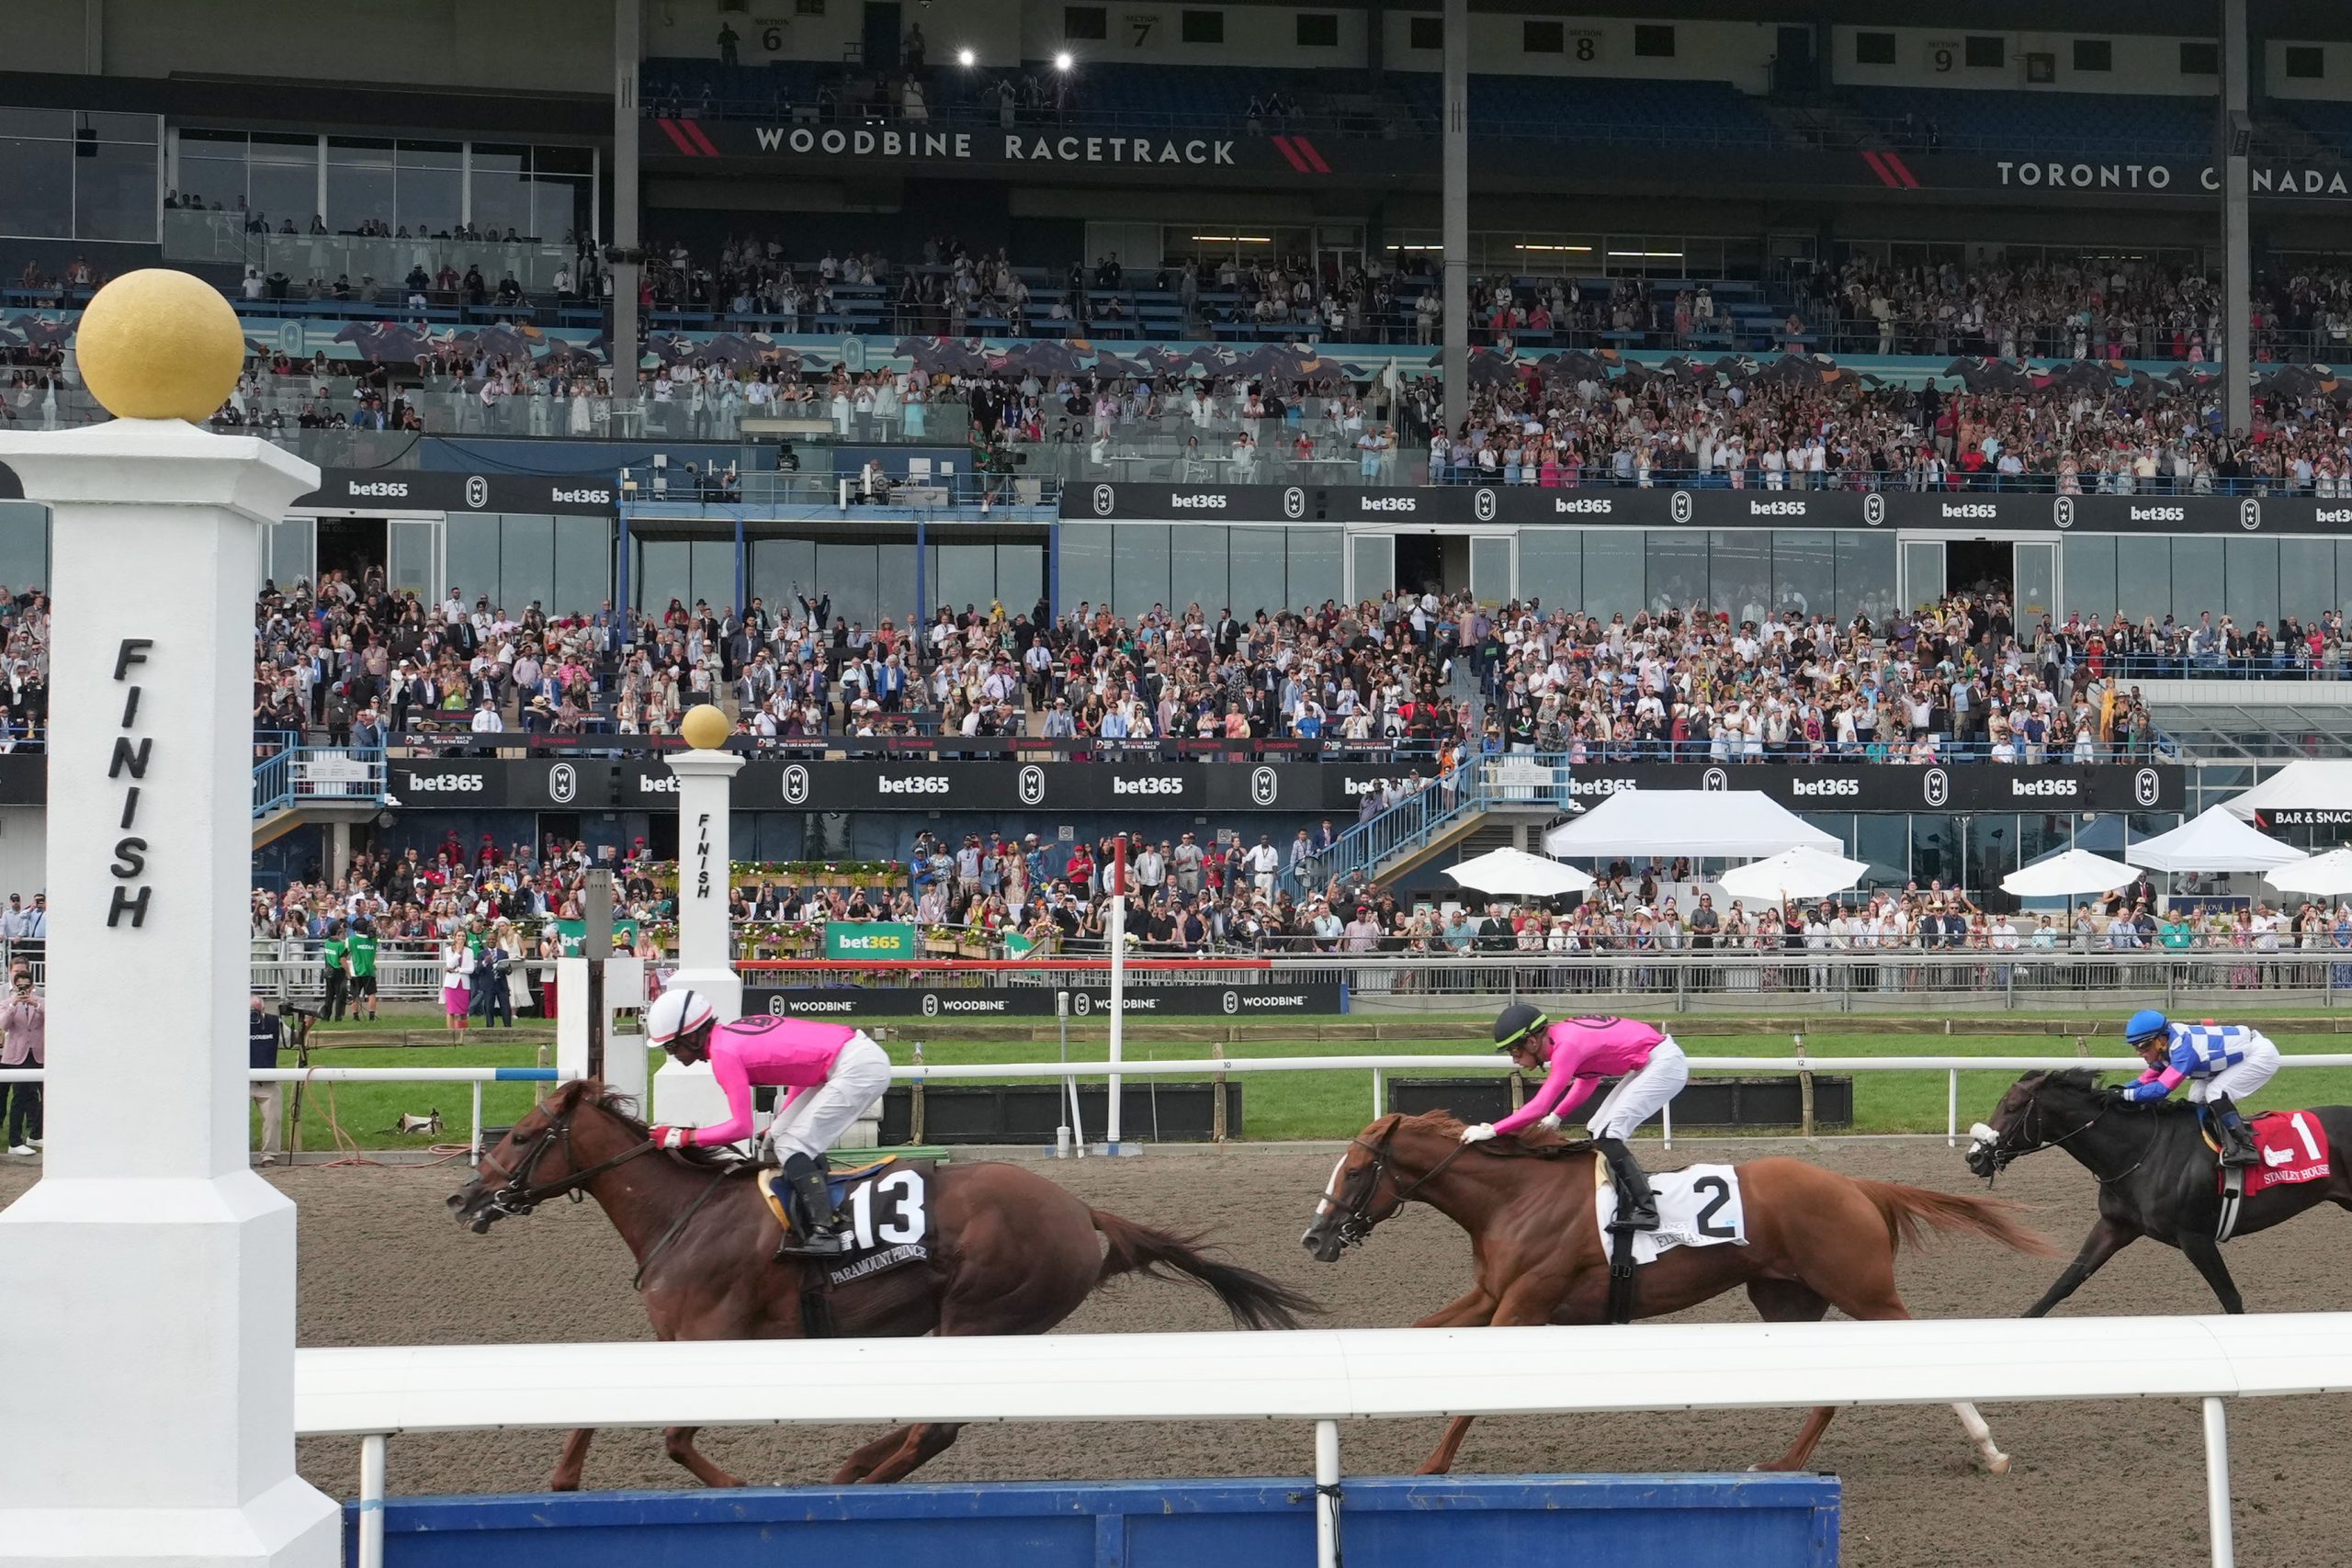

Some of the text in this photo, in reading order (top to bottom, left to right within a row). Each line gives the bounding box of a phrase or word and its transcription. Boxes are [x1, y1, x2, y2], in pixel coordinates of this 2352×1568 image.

[763, 28, 782, 51] 6
[1133, 24, 1152, 47] 7
[1576, 38, 1595, 61] 8
[1935, 50, 1952, 73] 9
[756, 127, 1236, 165] WOODBINE RACETRACK
[1997, 162, 2348, 194] TORONTO CNADA
[349, 481, 408, 497] bet365
[552, 488, 610, 503] bet365
[1171, 494, 1227, 509] bet365
[1361, 497, 1416, 512] bet365
[1555, 499, 1612, 513] bet365
[1750, 501, 1806, 515] bet365
[1942, 502, 1996, 518] bet365
[2131, 506, 2185, 521] bet365
[2316, 508, 2352, 523] bet3
[107, 638, 154, 929] FINISH
[410, 773, 483, 792] bet365
[640, 775, 680, 792] bet
[879, 776, 950, 794] bet365
[1114, 776, 1183, 795] bet365
[1792, 779, 1860, 795] bet365
[2012, 779, 2077, 795] bet365
[2275, 812, 2352, 824] BAR & SNAC
[696, 813, 710, 898] FINISH
[839, 935, 900, 949] bet365
[790, 1001, 853, 1012] WOODBINE
[944, 1000, 1004, 1010] WOODBINE
[1095, 998, 1156, 1009] WODBINE
[1243, 997, 1304, 1007] WOODBINE
[1224, 1061, 1232, 1069] 10
[1797, 1058, 1805, 1066] 12
[2290, 1112, 2322, 1160] 1
[2263, 1164, 2330, 1184] STANLEY HOUSE
[849, 1169, 926, 1249] 13
[1693, 1176, 1736, 1238] 2
[831, 1244, 928, 1284] PARAMOUNT PRINCE
